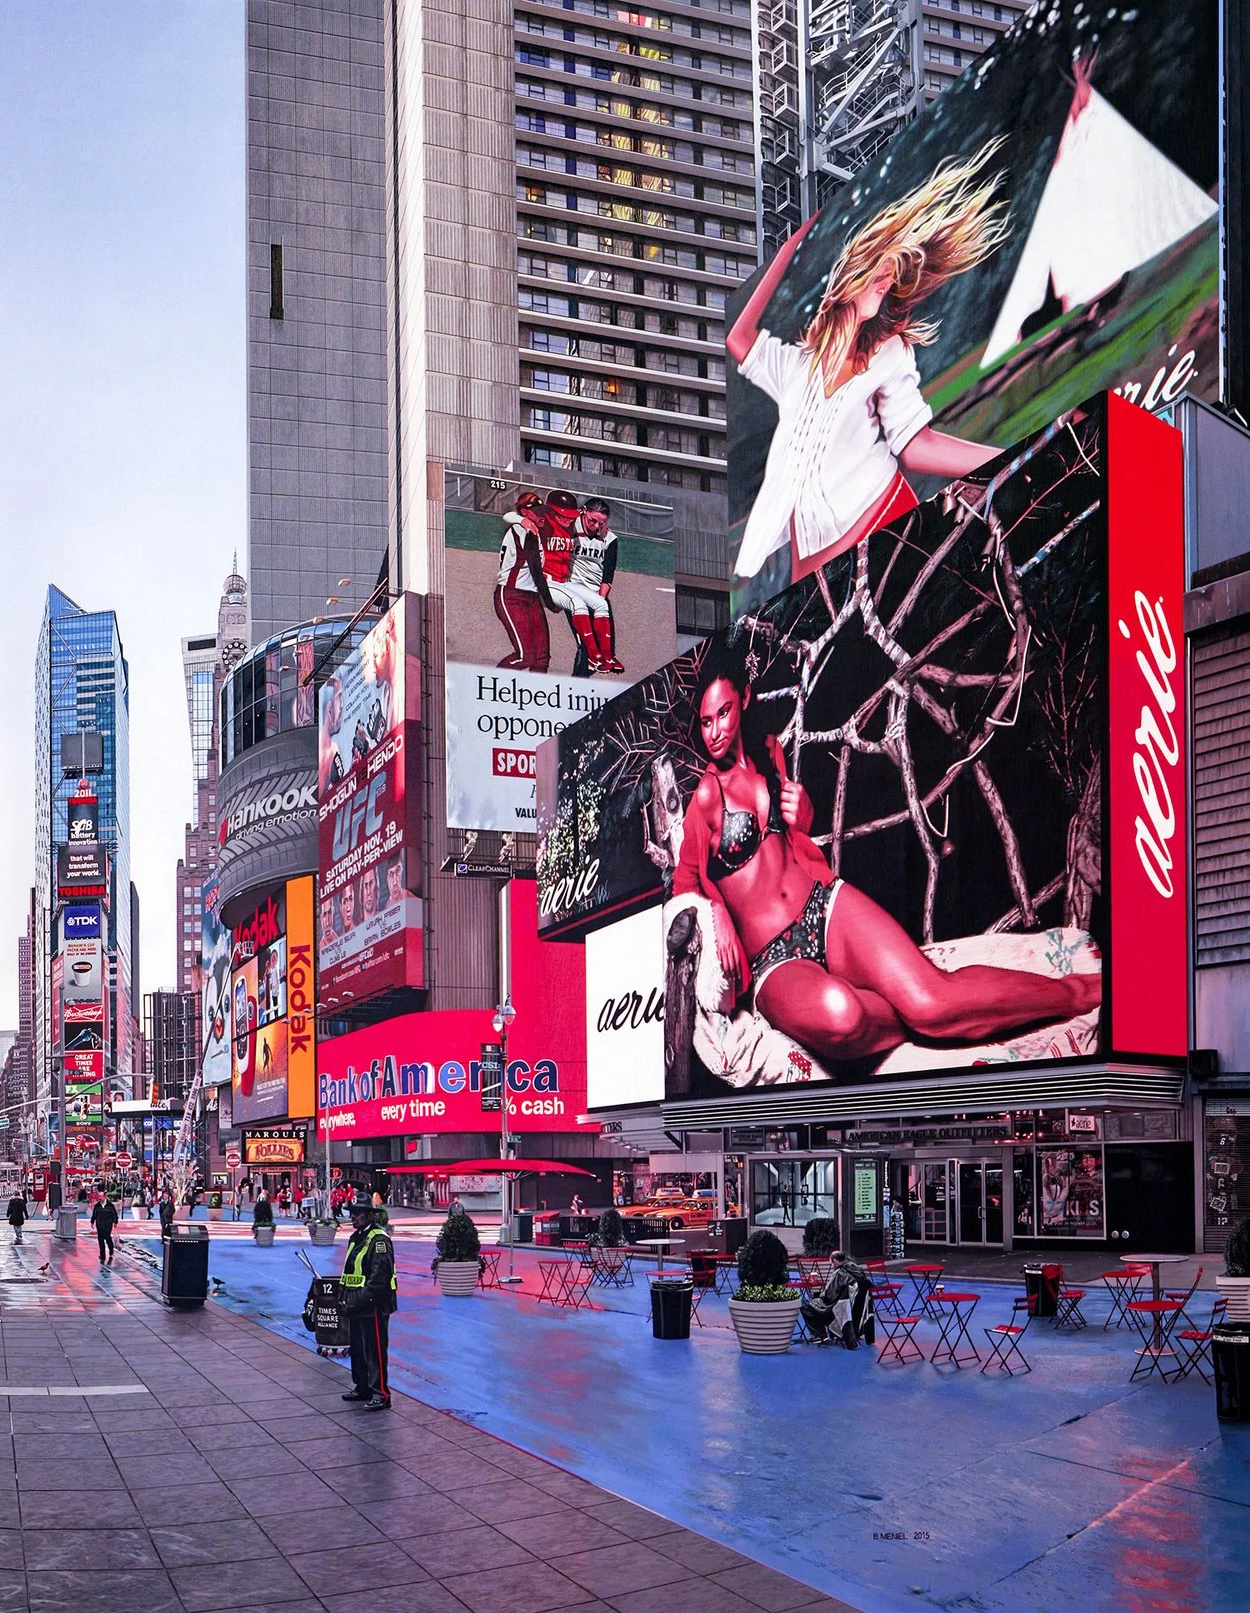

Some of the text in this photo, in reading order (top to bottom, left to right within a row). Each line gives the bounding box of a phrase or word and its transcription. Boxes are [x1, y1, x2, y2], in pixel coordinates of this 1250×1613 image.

[1113, 344, 1196, 410] rie
[490, 480, 506, 490] 215
[476, 675, 562, 711] Helped
[477, 713, 574, 741] oppone
[367, 734, 403, 779] HENDO
[319, 777, 357, 822] SHOGUN
[235, 808, 317, 840] driving emotion
[332, 771, 387, 862] UFC
[320, 829, 403, 898] LIVE ON PAY-PER-VIEW
[326, 821, 397, 882] SATURDAY NOV. 19
[67, 871, 81, 879] your
[540, 855, 600, 917] aerie
[59, 886, 105, 897] TOSHIBA
[75, 916, 98, 925] TDK
[289, 944, 311, 1055] Kodak
[319, 1067, 357, 1110] Bank
[359, 1059, 382, 1101] of
[381, 1055, 560, 1099] Amerca
[381, 1096, 564, 1123] every time cash
[1075, 1117, 1092, 1129] aerie
[848, 1125, 1008, 1142] AMERICAN EAGLE OUTFITTERS
[255, 1143, 295, 1160] FOLLIES
[322, 1283, 333, 1294] 12
[317, 1314, 339, 1322] SQUARE
[318, 1307, 337, 1315] TIMES
